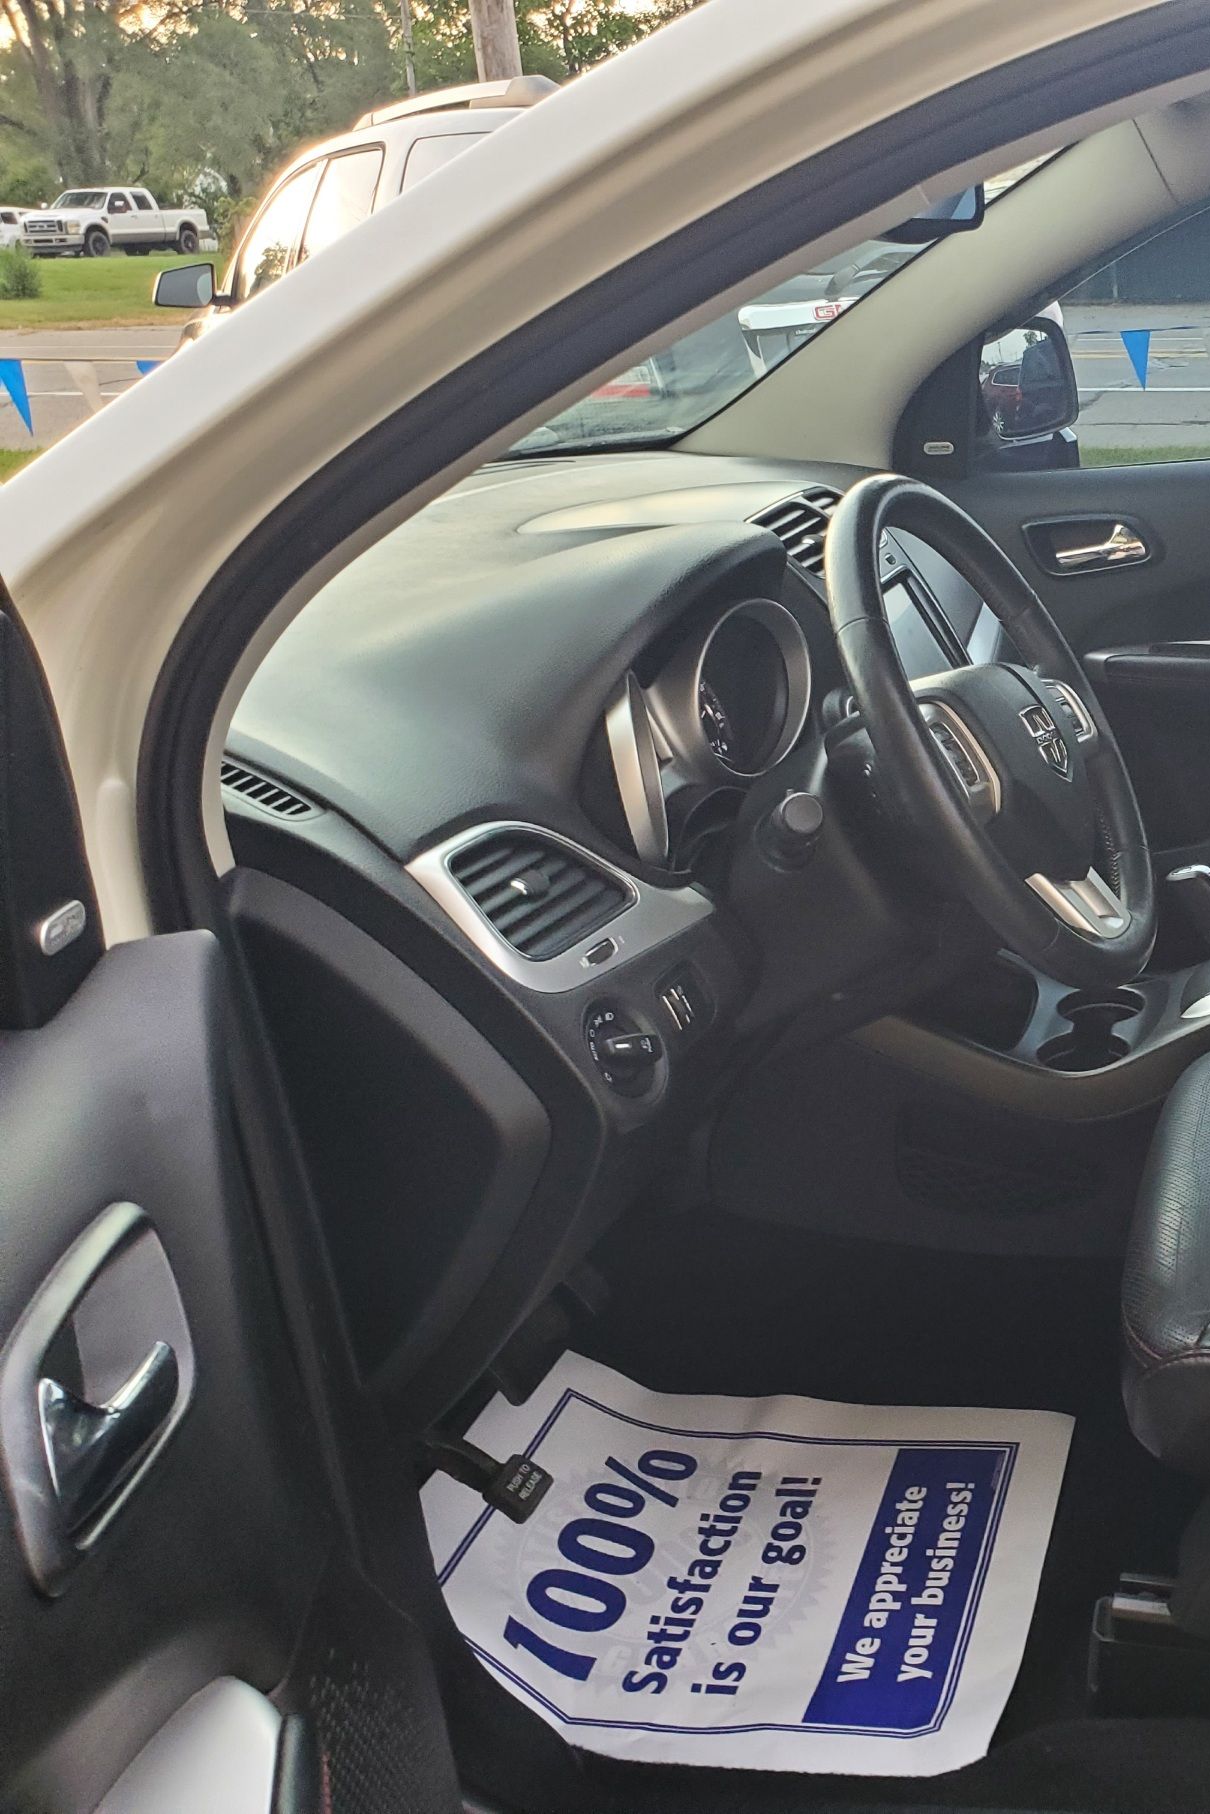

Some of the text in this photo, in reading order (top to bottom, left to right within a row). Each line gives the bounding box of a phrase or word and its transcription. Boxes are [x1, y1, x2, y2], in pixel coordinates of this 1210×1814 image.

[504, 1450, 698, 1682] 100%
[506, 1463, 531, 1493] PUSH TO
[518, 1470, 543, 1501] RELEASE
[622, 1471, 762, 1695] Satisfaction
[691, 1476, 823, 1695] is our goal!
[836, 1486, 928, 1683] We appreciate
[896, 1482, 976, 1683] your business!
